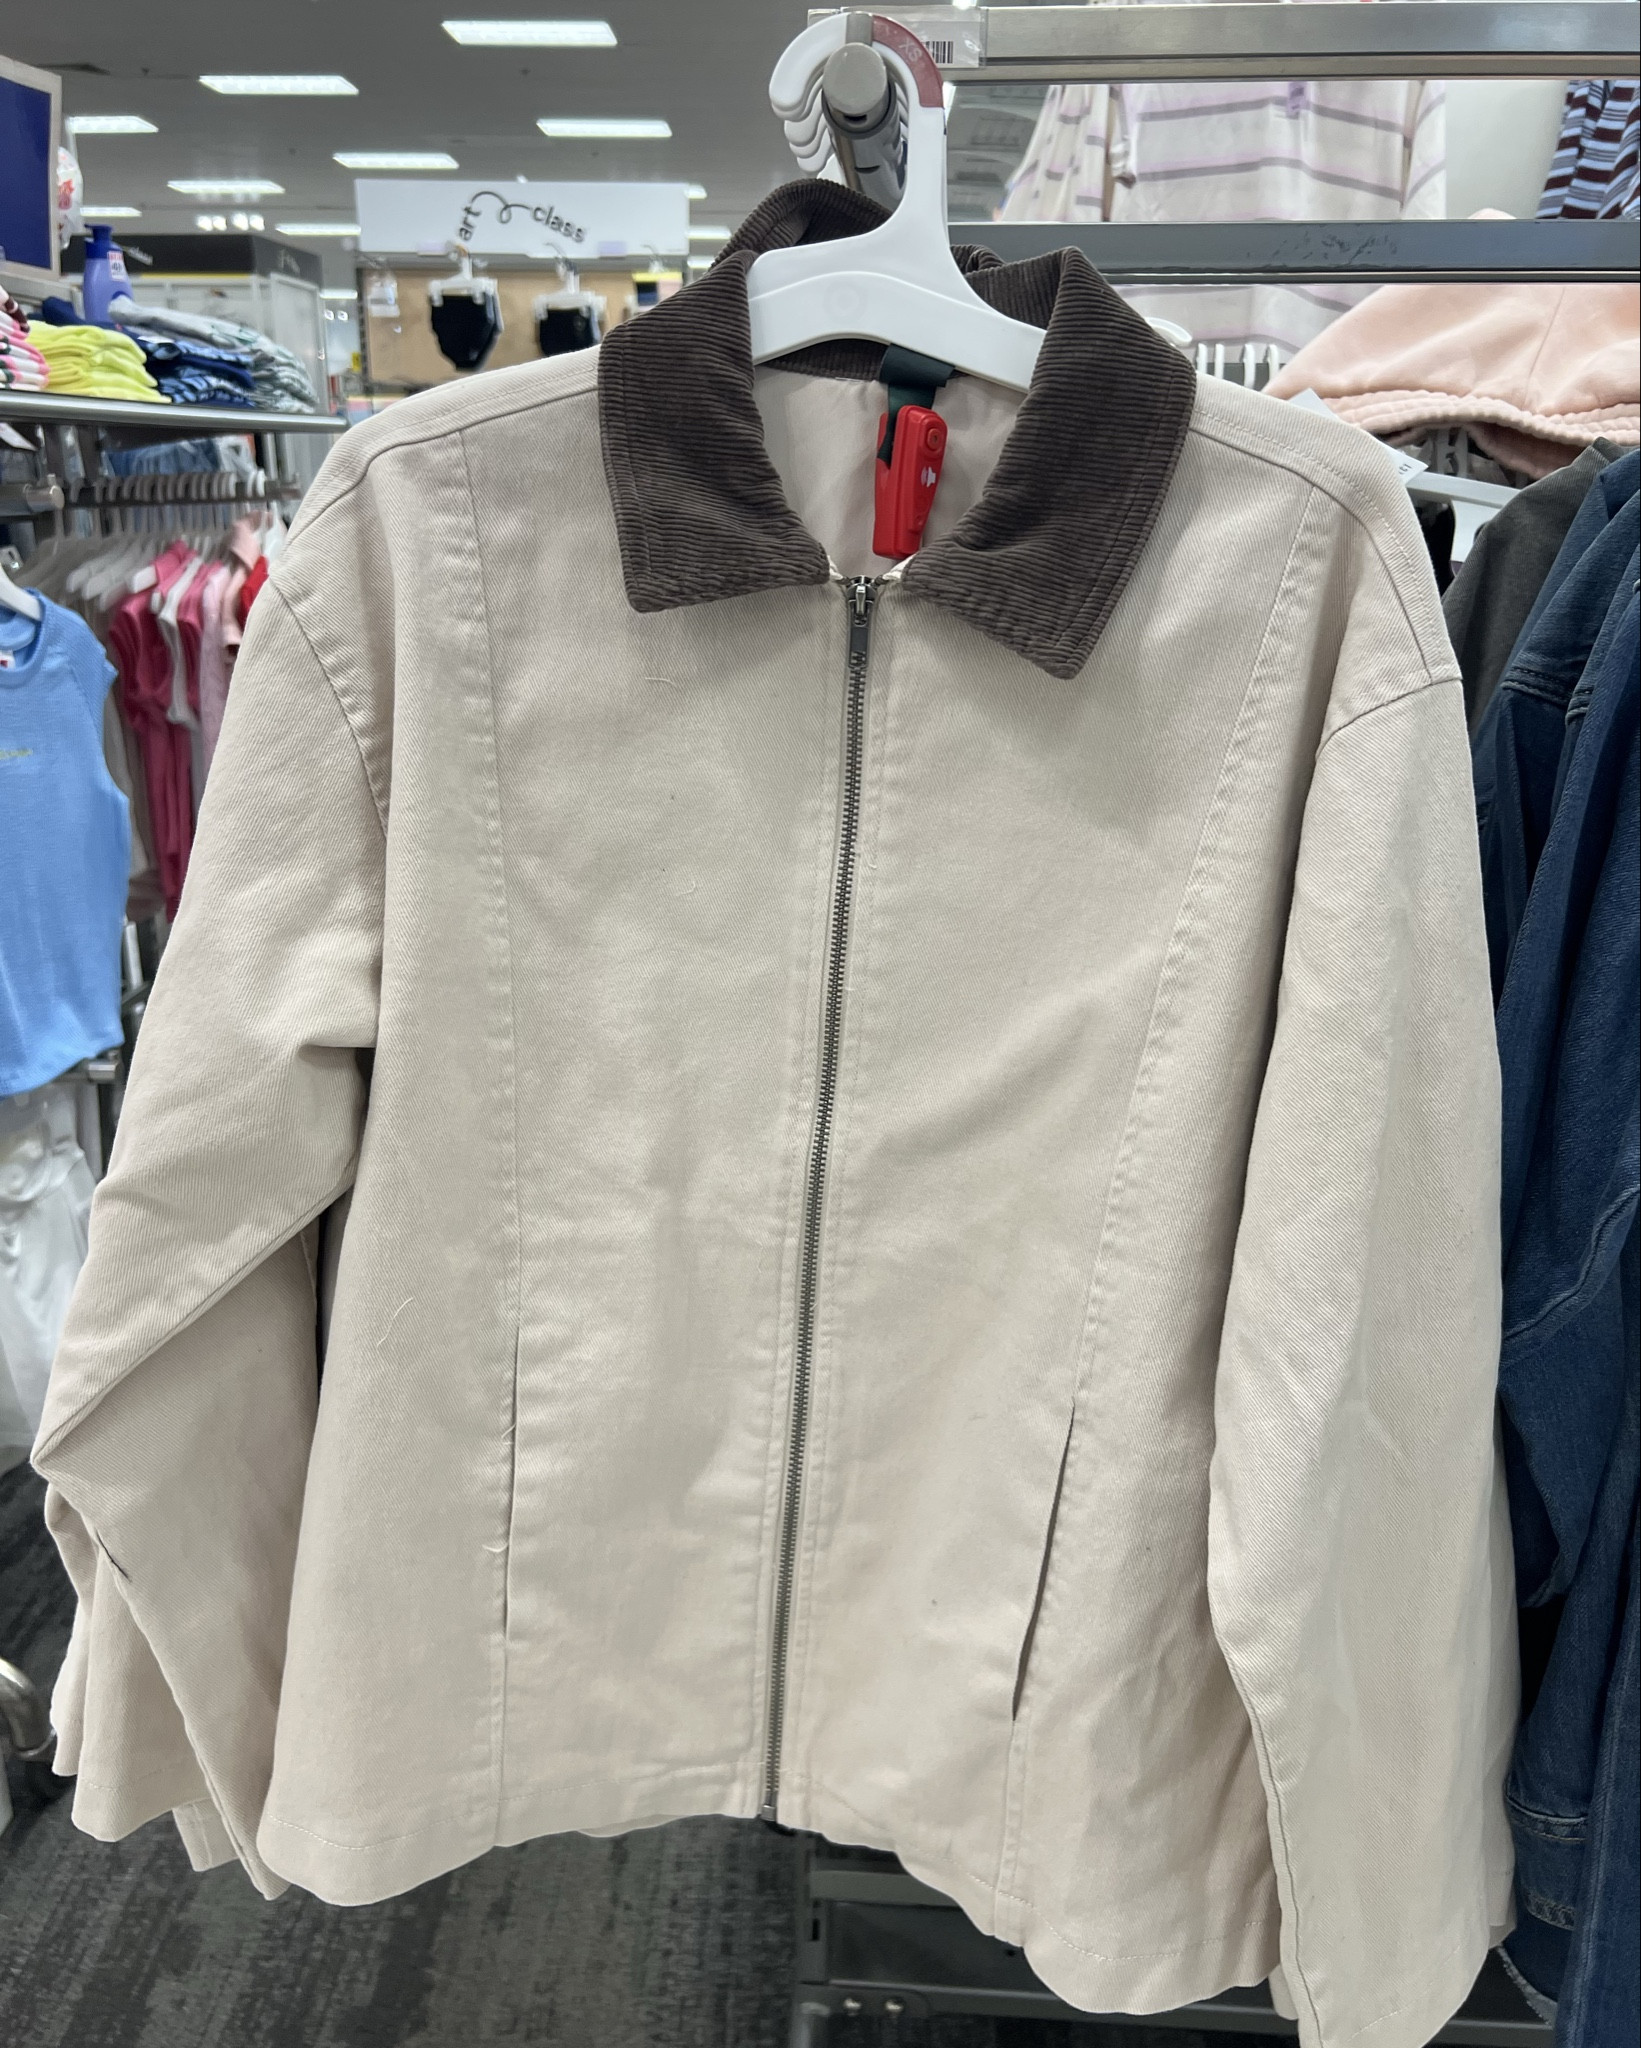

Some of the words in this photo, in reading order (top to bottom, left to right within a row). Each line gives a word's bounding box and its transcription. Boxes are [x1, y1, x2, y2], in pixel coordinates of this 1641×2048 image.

[898, 37, 923, 62] XS
[459, 206, 481, 241] art
[533, 206, 585, 243] class
